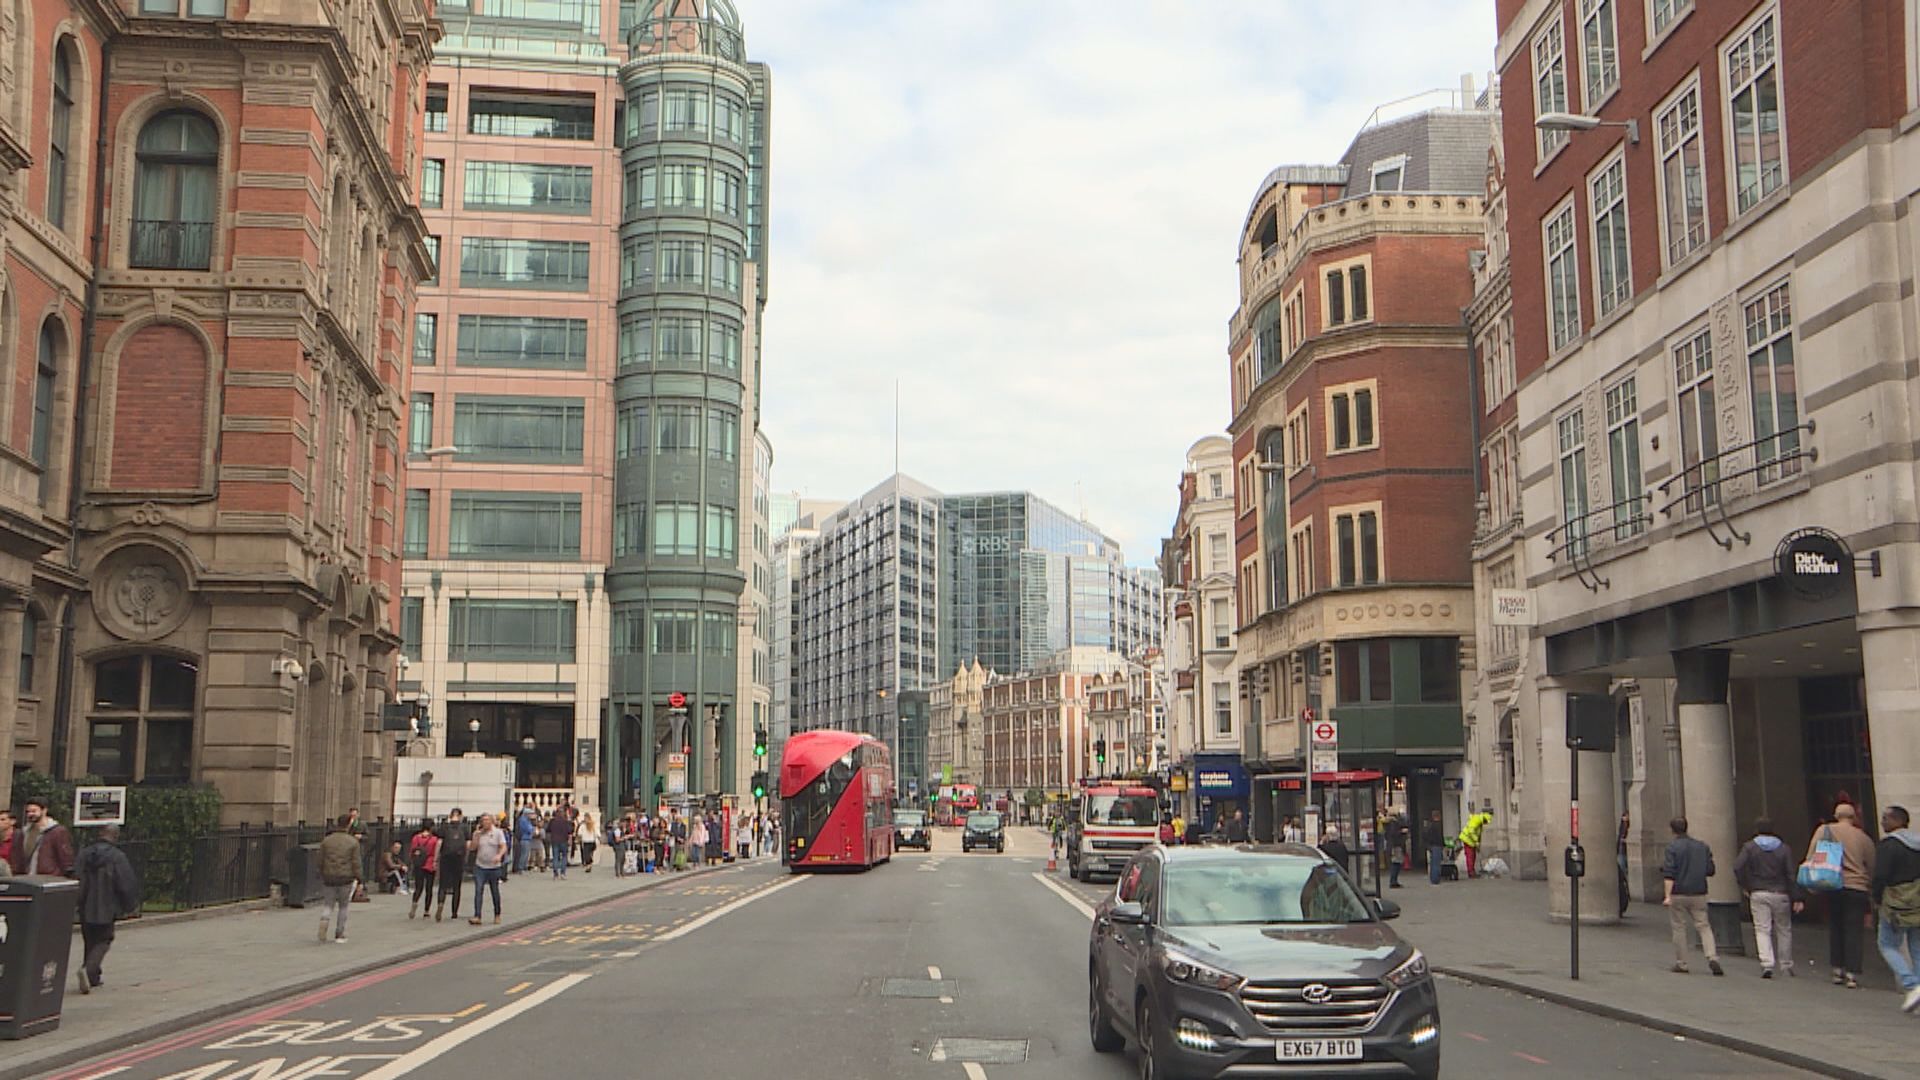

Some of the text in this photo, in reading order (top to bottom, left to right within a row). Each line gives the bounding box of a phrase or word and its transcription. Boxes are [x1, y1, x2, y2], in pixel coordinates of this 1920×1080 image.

[980, 536, 1009, 552] RBS
[1795, 552, 1824, 565] Dirty
[1796, 561, 1839, 573] martini
[1304, 708, 1313, 720] K
[203, 1019, 453, 1049] BUS
[1283, 1040, 1356, 1056] EX67 BTO
